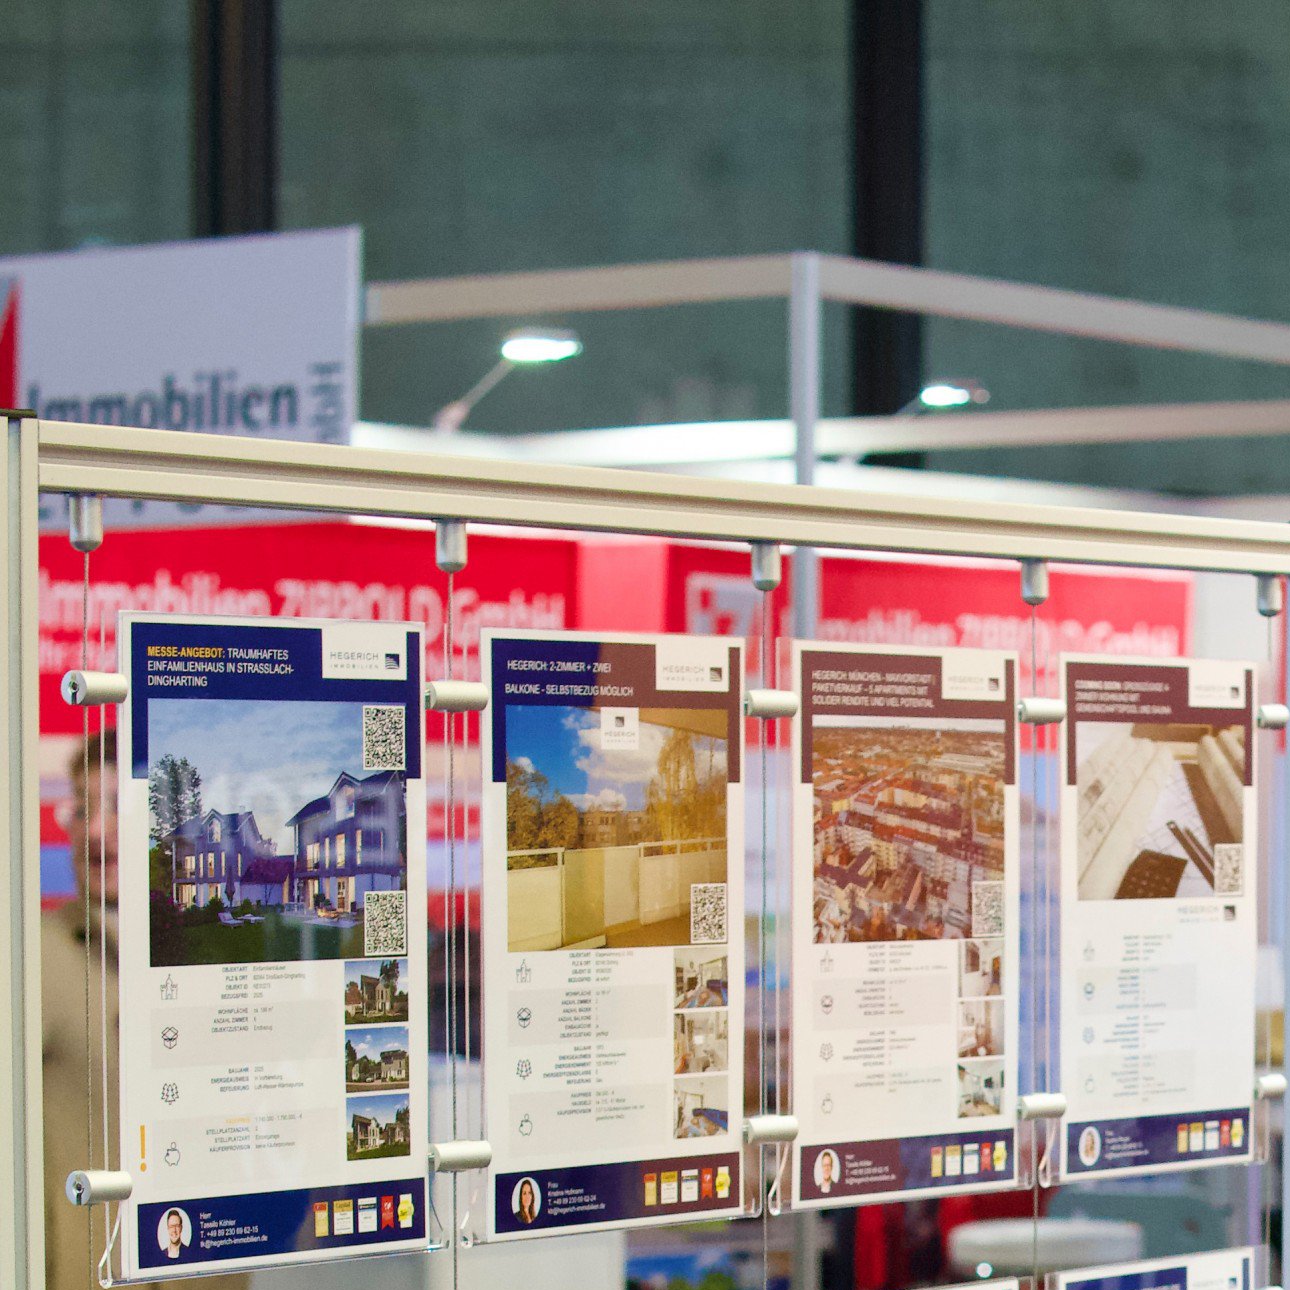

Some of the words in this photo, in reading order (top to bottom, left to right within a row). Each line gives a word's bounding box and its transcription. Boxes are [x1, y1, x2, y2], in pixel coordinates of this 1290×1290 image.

[148, 646, 225, 658] MESSE-ANGEBOT:
[228, 648, 289, 660] TRAUMHAFTES
[330, 652, 379, 661] HEGERICH
[148, 661, 224, 673] EINFAMILIENHAUS
[227, 663, 234, 673] IN
[237, 663, 294, 675] STRASSLACH-
[508, 660, 548, 671] HEGERICH:
[550, 662, 584, 672] 2-ZIMMER
[587, 663, 591, 672] +
[593, 663, 611, 673] ZWEI
[663, 666, 704, 674] HEGERICH
[148, 675, 208, 687] DINGHARTING
[505, 684, 540, 695] BALKONE
[546, 685, 598, 696] SELBSTBEZUG
[600, 685, 633, 696] MÖGLICH
